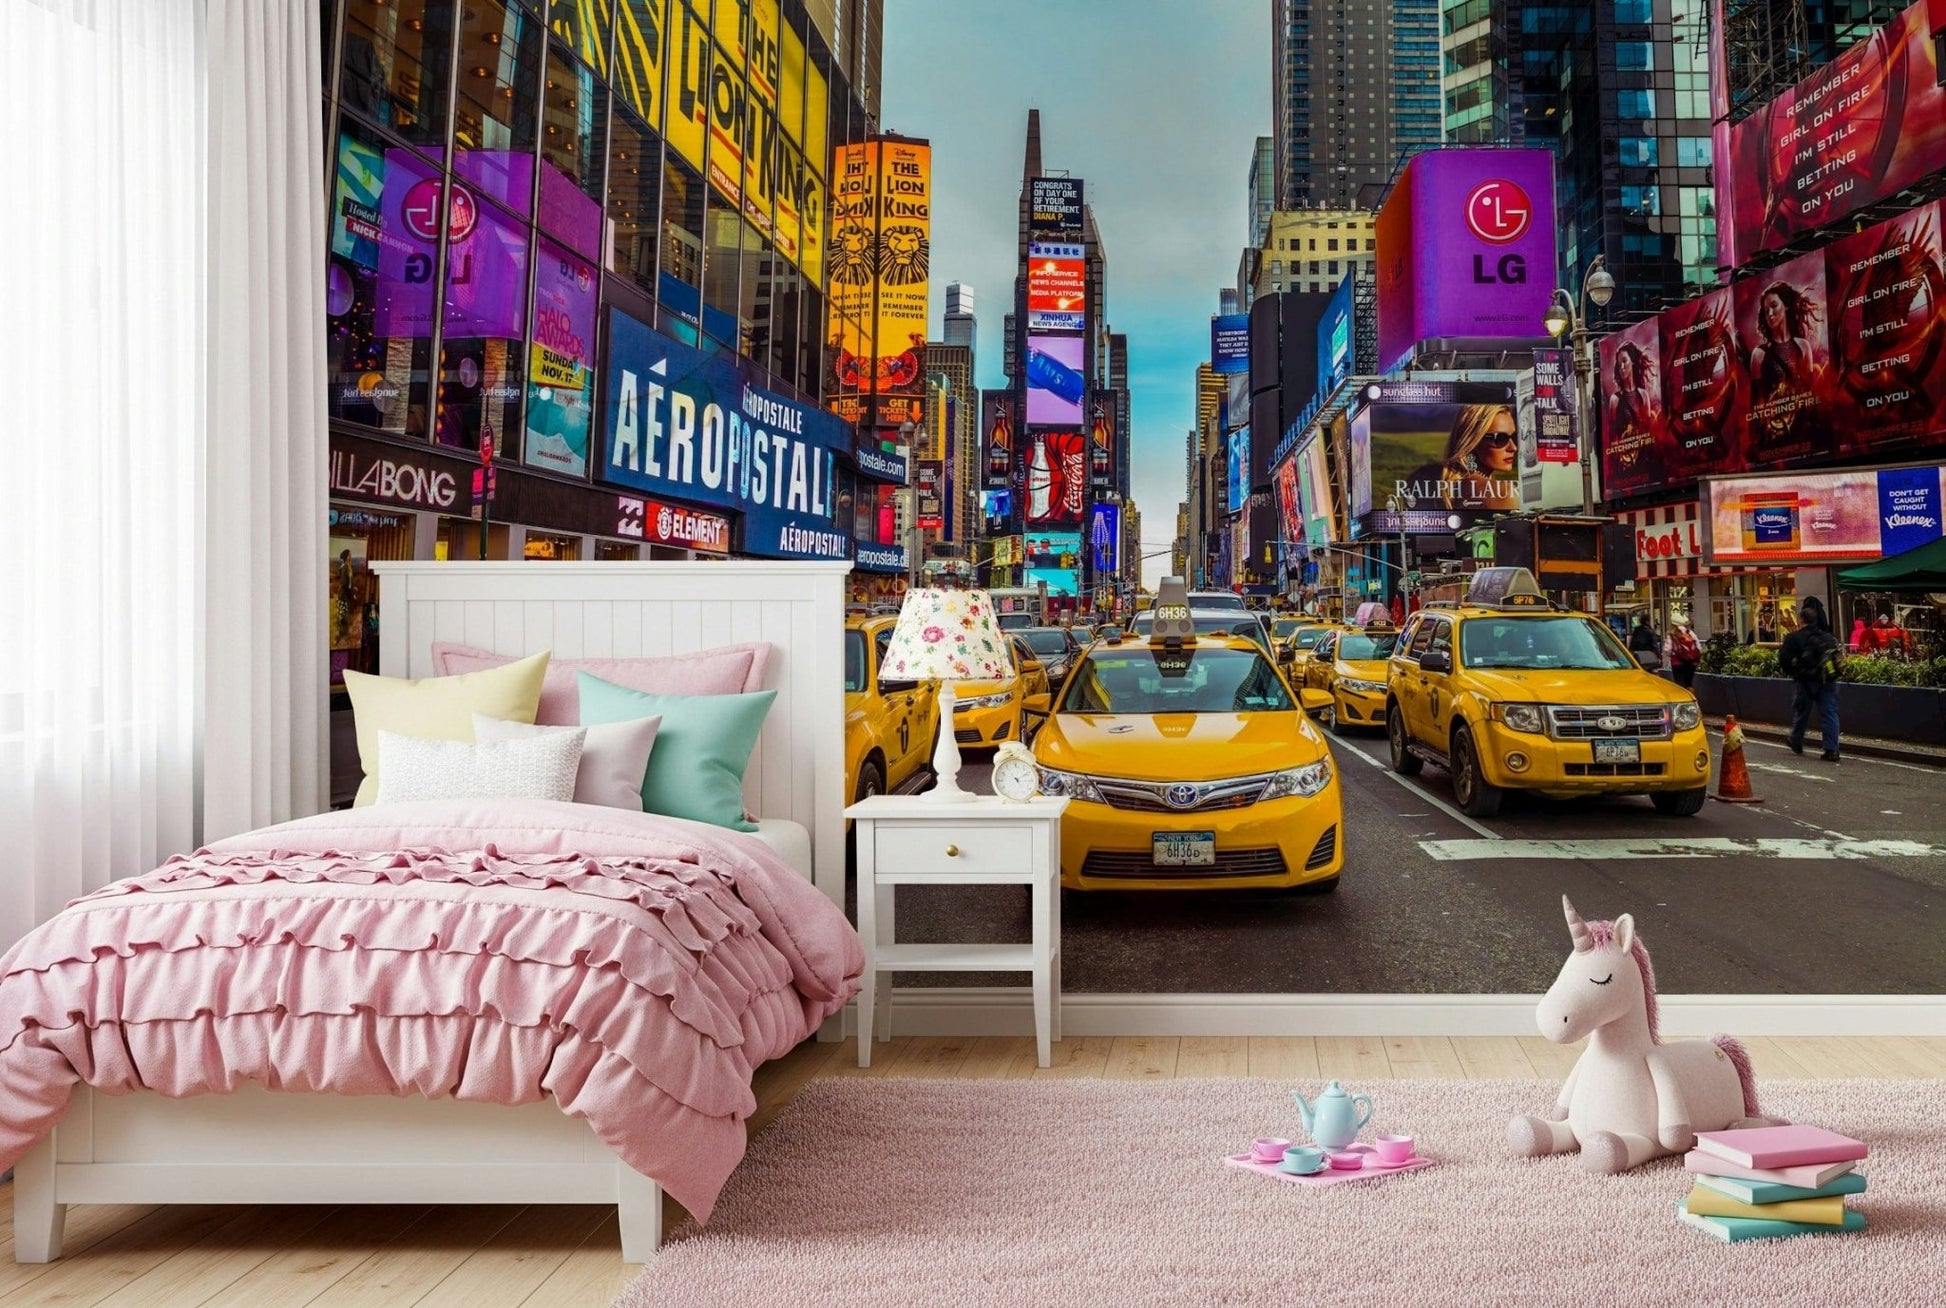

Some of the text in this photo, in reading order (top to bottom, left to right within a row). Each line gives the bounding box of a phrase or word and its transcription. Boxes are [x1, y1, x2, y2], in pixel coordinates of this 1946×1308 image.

[1786, 63, 1860, 118] REMEMBER
[1780, 84, 1870, 148] GIRL ON FIRE
[1795, 124, 1857, 165] I'M STILL
[758, 94, 818, 233] KING
[892, 161, 919, 175] THE
[1797, 149, 1857, 190] BETTING
[887, 175, 925, 194] LION
[1033, 181, 1073, 190] CONGRATS
[1033, 189, 1044, 197] ON
[1062, 190, 1078, 198] ONE
[1044, 197, 1065, 205] YOUR
[1801, 178, 1854, 214] ON YOU
[348, 202, 377, 222] Hosted
[884, 196, 928, 218] KING
[1033, 204, 1080, 214] RETIREMENT
[1033, 212, 1056, 220] DIANA
[352, 222, 376, 239] NICK
[1850, 243, 1911, 274] REMEMBER
[1472, 253, 1528, 285] LG
[881, 291, 894, 299] SEE
[905, 293, 928, 301] NOW.
[1847, 277, 1918, 308] GIRL ON FIRE
[883, 302, 924, 312] REMEMBER
[890, 311, 928, 320] FOREVER.
[1033, 320, 1052, 328] NEWS
[1040, 313, 1073, 322] XINHUA
[1674, 318, 1715, 339] REMEMBER
[1859, 319, 1909, 340] I'M STILL
[1673, 346, 1720, 367] GIRL ON FIRE
[1861, 353, 1911, 374] BETTING
[541, 364, 563, 381] NOV.
[1535, 362, 1560, 375] SOME
[1535, 374, 1564, 386] WALLS
[1692, 378, 1714, 390] STILL
[1382, 385, 1441, 398] sunglass hut
[1866, 391, 1909, 409] ON YOU
[742, 381, 803, 435] AÉROPOSTALE
[889, 399, 909, 408] GET
[1537, 397, 1557, 409] TALK
[1682, 406, 1715, 421] BETTING
[1745, 402, 1796, 422] CATCHING
[1605, 440, 1640, 455] CATCHING
[1685, 435, 1714, 449] ON YOU
[329, 449, 456, 507] ILLABONG
[919, 467, 935, 476] SOME
[1395, 480, 1464, 499] RALPH
[1889, 488, 1929, 498] DON'T GET
[1892, 503, 1928, 512] WITHOUT
[1894, 496, 1925, 505] CAUGHT
[1884, 512, 1934, 529] Kleenex
[672, 513, 722, 546] ELEMENT
[780, 520, 846, 559] AÉROPOSTALE
[1636, 527, 1682, 560] Foot
[1158, 606, 1188, 620] 6H36
